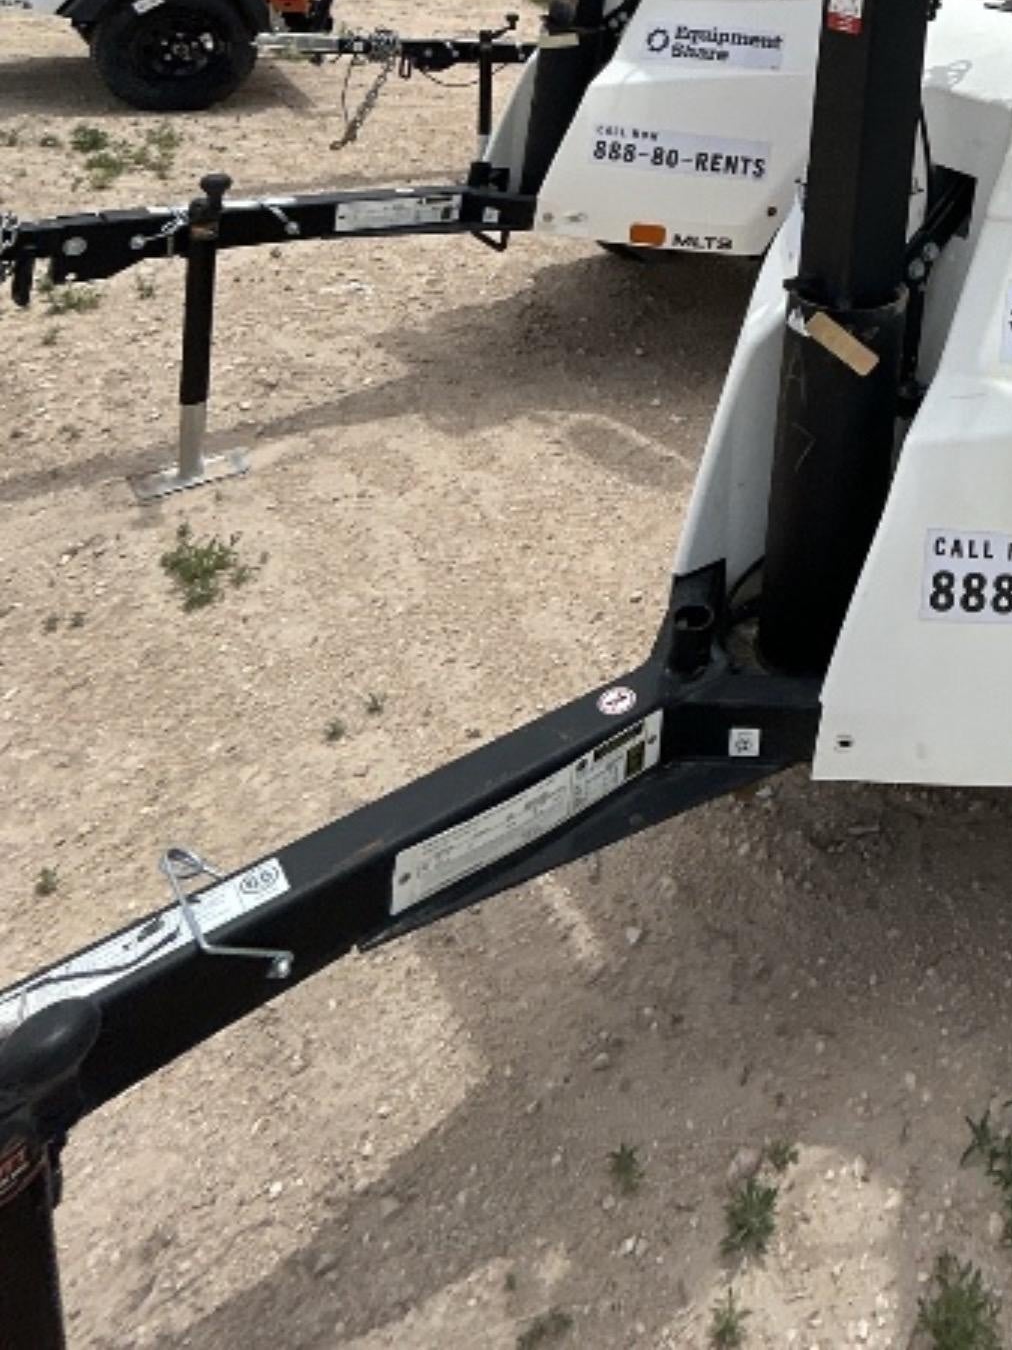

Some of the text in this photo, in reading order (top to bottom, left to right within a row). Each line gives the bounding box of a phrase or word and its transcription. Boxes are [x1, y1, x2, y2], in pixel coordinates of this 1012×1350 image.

[674, 26, 784, 50] Equipment
[671, 42, 729, 61] Share
[593, 140, 767, 179] 888-80-RENTS
[934, 536, 994, 560] CALL
